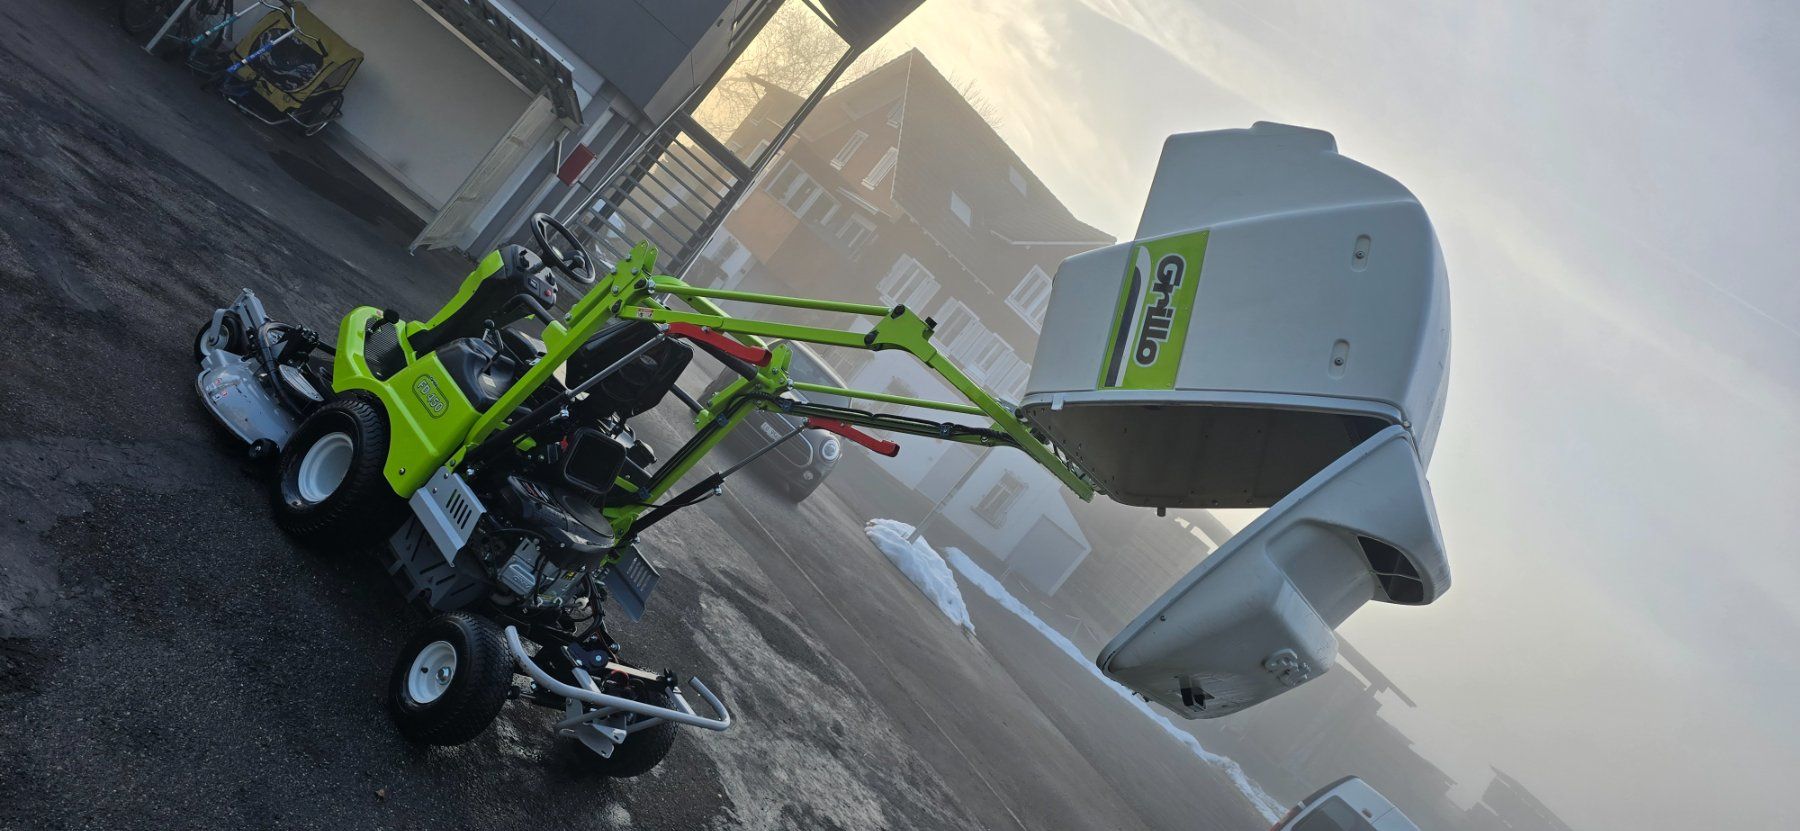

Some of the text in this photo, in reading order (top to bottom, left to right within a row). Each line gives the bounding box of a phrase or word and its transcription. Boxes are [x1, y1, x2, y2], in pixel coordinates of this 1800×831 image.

[1134, 254, 1187, 367] Grillo
[417, 381, 430, 395] FD
[428, 394, 443, 412] 450
